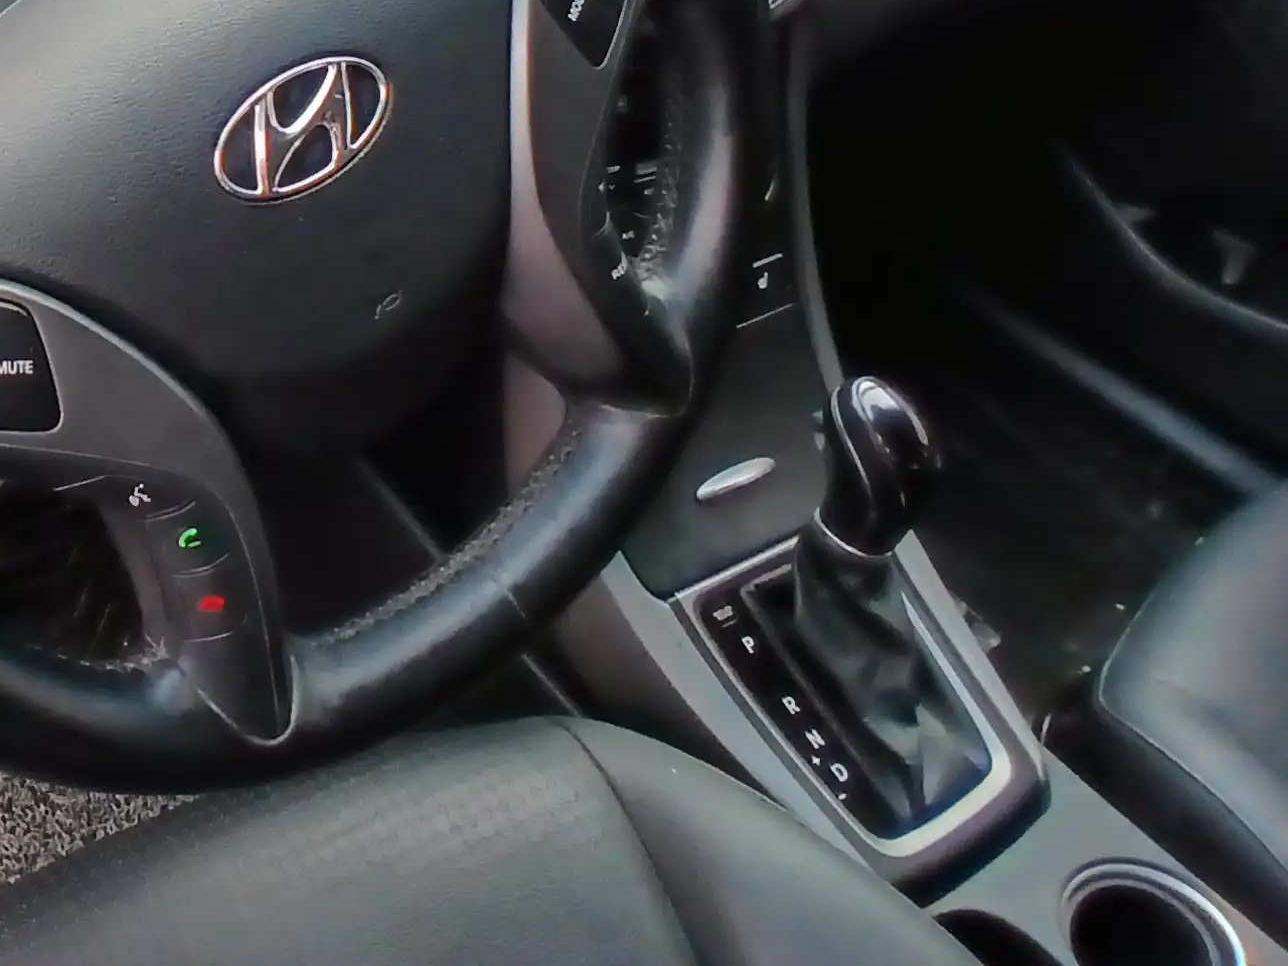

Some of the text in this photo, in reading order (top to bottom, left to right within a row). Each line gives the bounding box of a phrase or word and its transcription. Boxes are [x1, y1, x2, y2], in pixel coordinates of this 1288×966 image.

[741, 636, 755, 654] P
[781, 695, 801, 715] R
[804, 728, 826, 750] N
[829, 762, 849, 783] D
